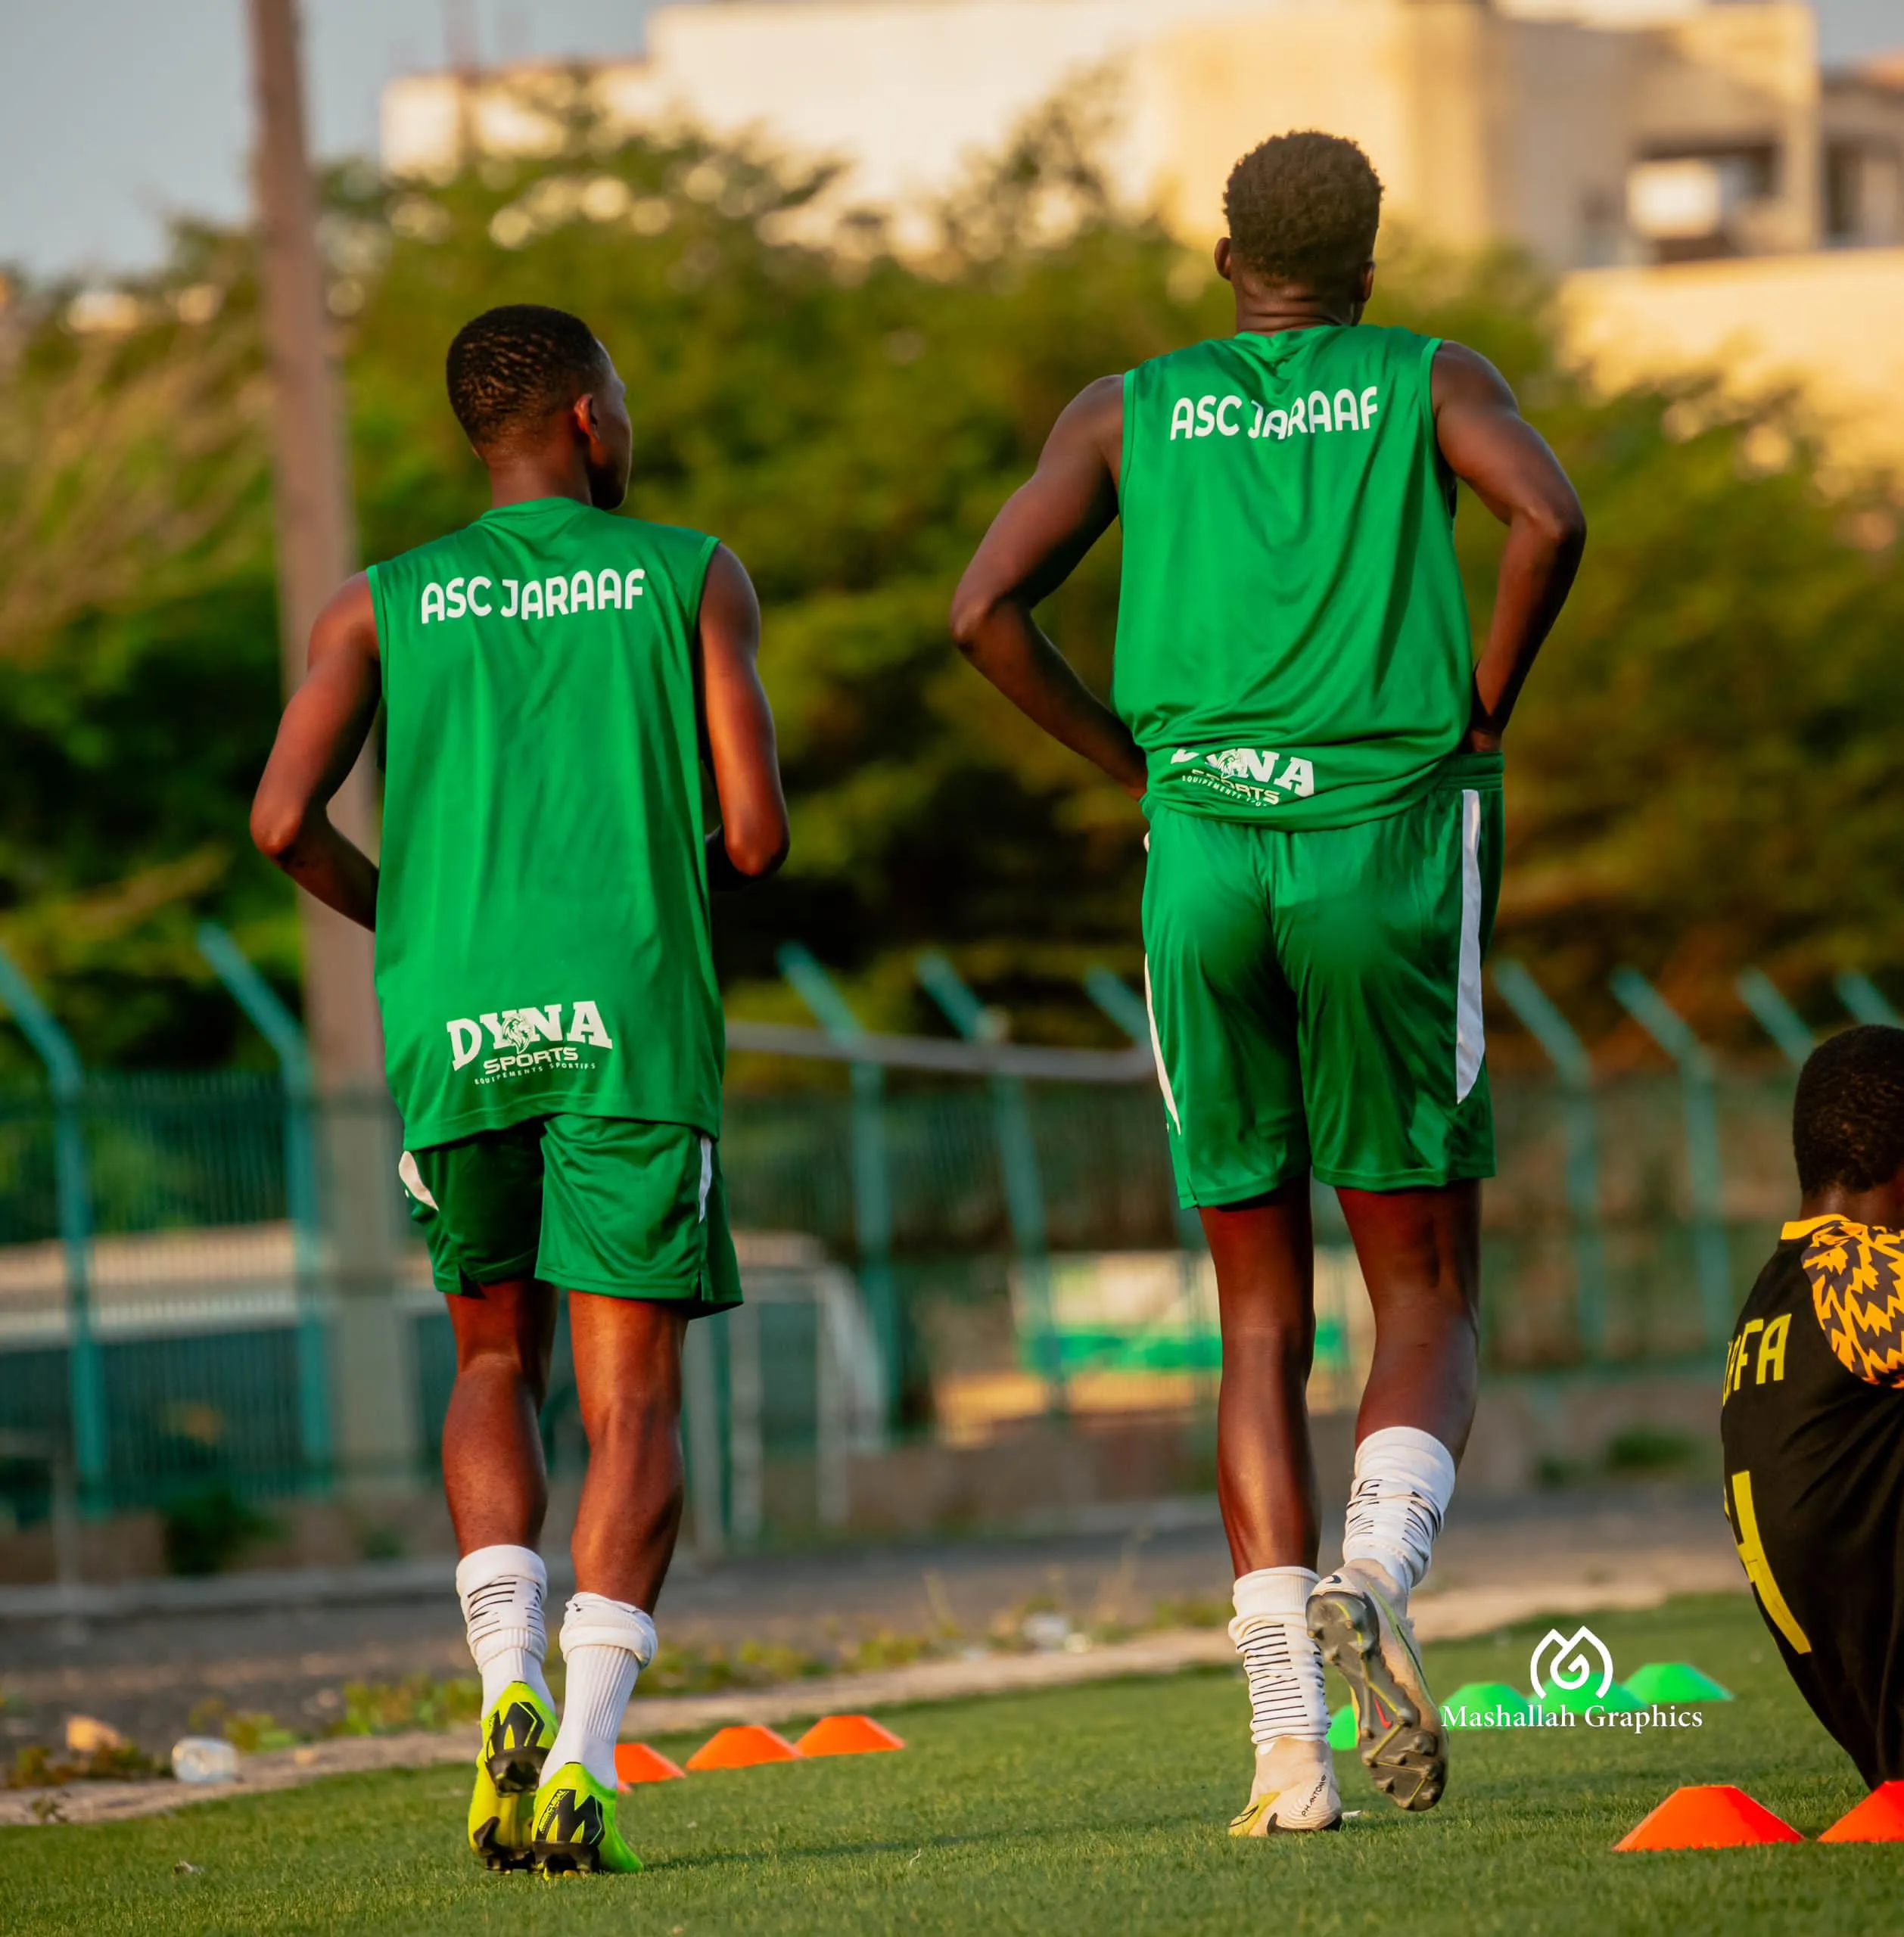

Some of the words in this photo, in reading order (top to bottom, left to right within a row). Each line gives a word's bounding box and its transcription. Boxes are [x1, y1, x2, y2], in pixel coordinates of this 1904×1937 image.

[1170, 395, 1243, 440] ASC
[1247, 386, 1378, 440] JARAAF
[421, 576, 492, 623] ASC
[500, 568, 646, 620] JARAAF
[446, 1000, 613, 1071] DYNA
[484, 1047, 579, 1075] SPORTS
[474, 1066, 543, 1085] EQUIPEMENTS
